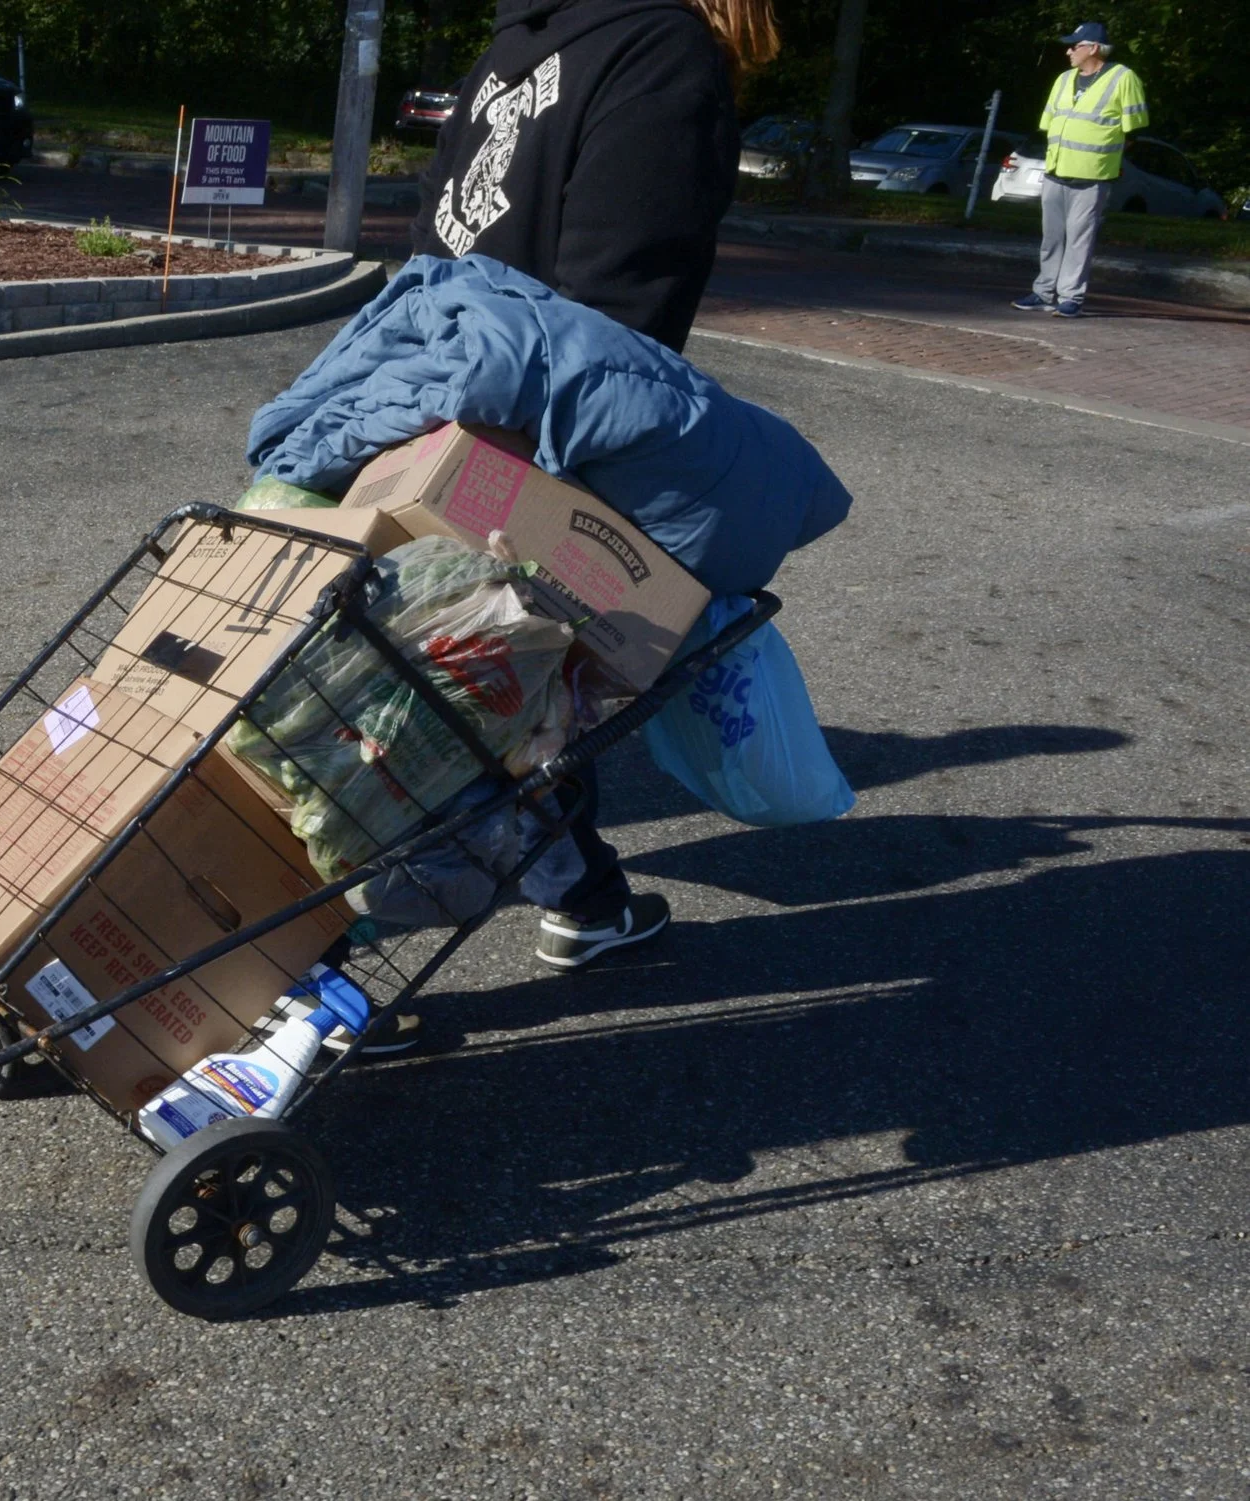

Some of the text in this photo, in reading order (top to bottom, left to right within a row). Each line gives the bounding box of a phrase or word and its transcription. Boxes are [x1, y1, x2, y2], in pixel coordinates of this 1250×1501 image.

[204, 124, 255, 143] MOUNTAIN
[207, 145, 247, 163] OF FOOD
[201, 176, 207, 184] 9
[226, 176, 232, 184] 11
[205, 167, 245, 176] THIS FRIDAY
[535, 566, 551, 580] ET
[70, 924, 108, 961] KEEP
[89, 911, 136, 957] FRESH
[172, 990, 206, 1027] EGGS
